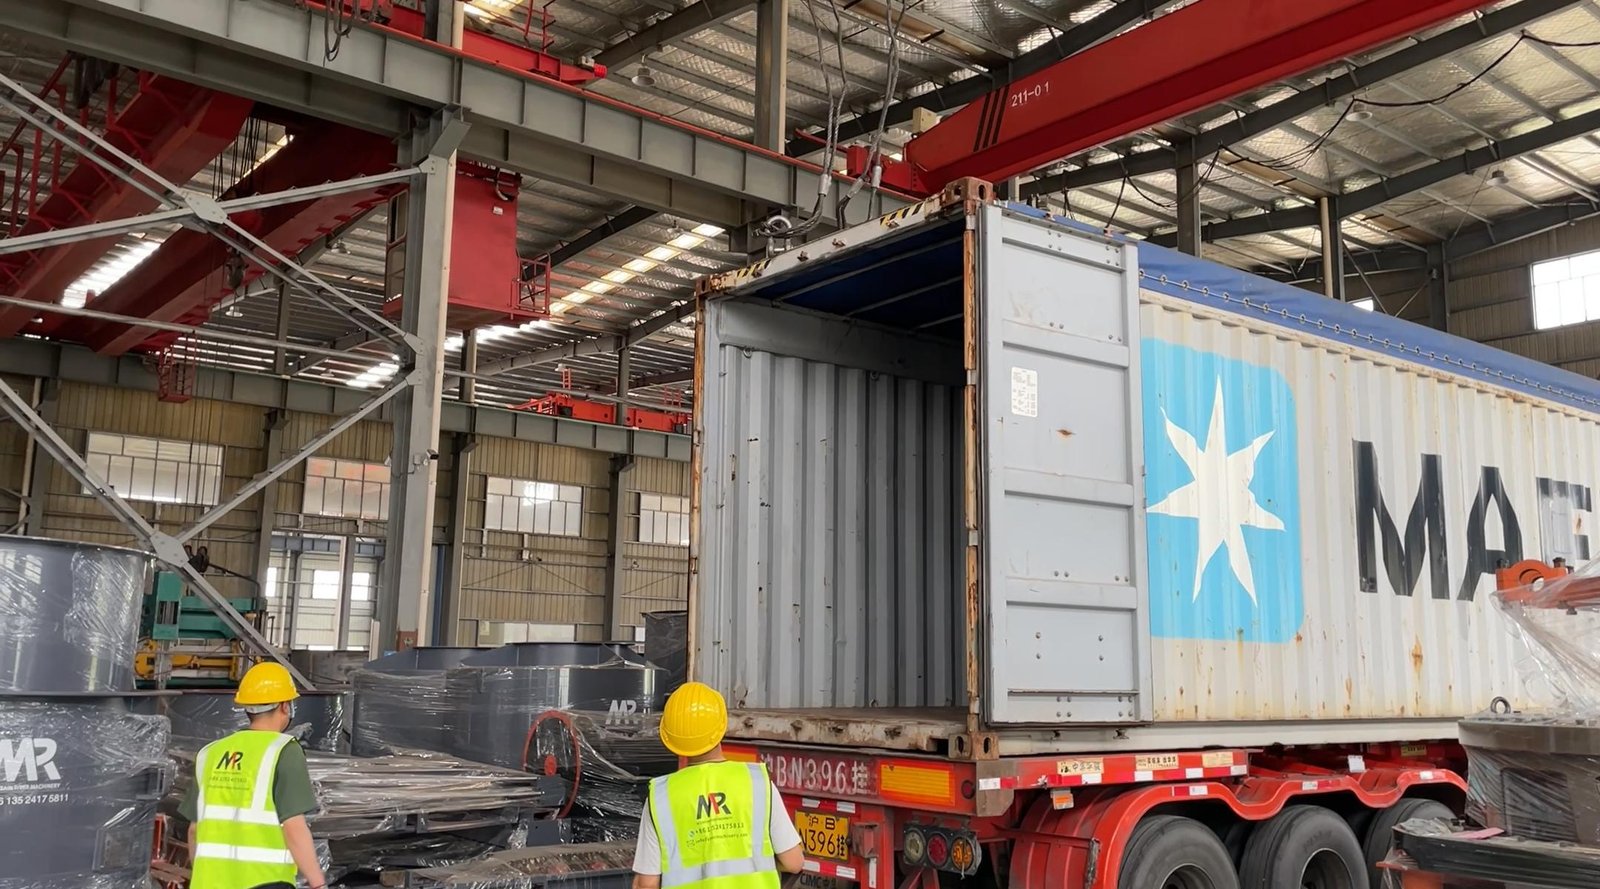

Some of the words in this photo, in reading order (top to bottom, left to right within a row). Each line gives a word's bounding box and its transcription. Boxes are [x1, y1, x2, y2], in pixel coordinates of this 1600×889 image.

[605, 699, 638, 725] MR
[0, 738, 61, 782] MR
[216, 751, 243, 770] MR
[7, 796, 24, 805] 135
[24, 794, 48, 804] 2417
[48, 793, 69, 803] 5811
[696, 792, 731, 820] MR
[798, 828, 846, 857] N396挂
[800, 873, 822, 888] CIMC
